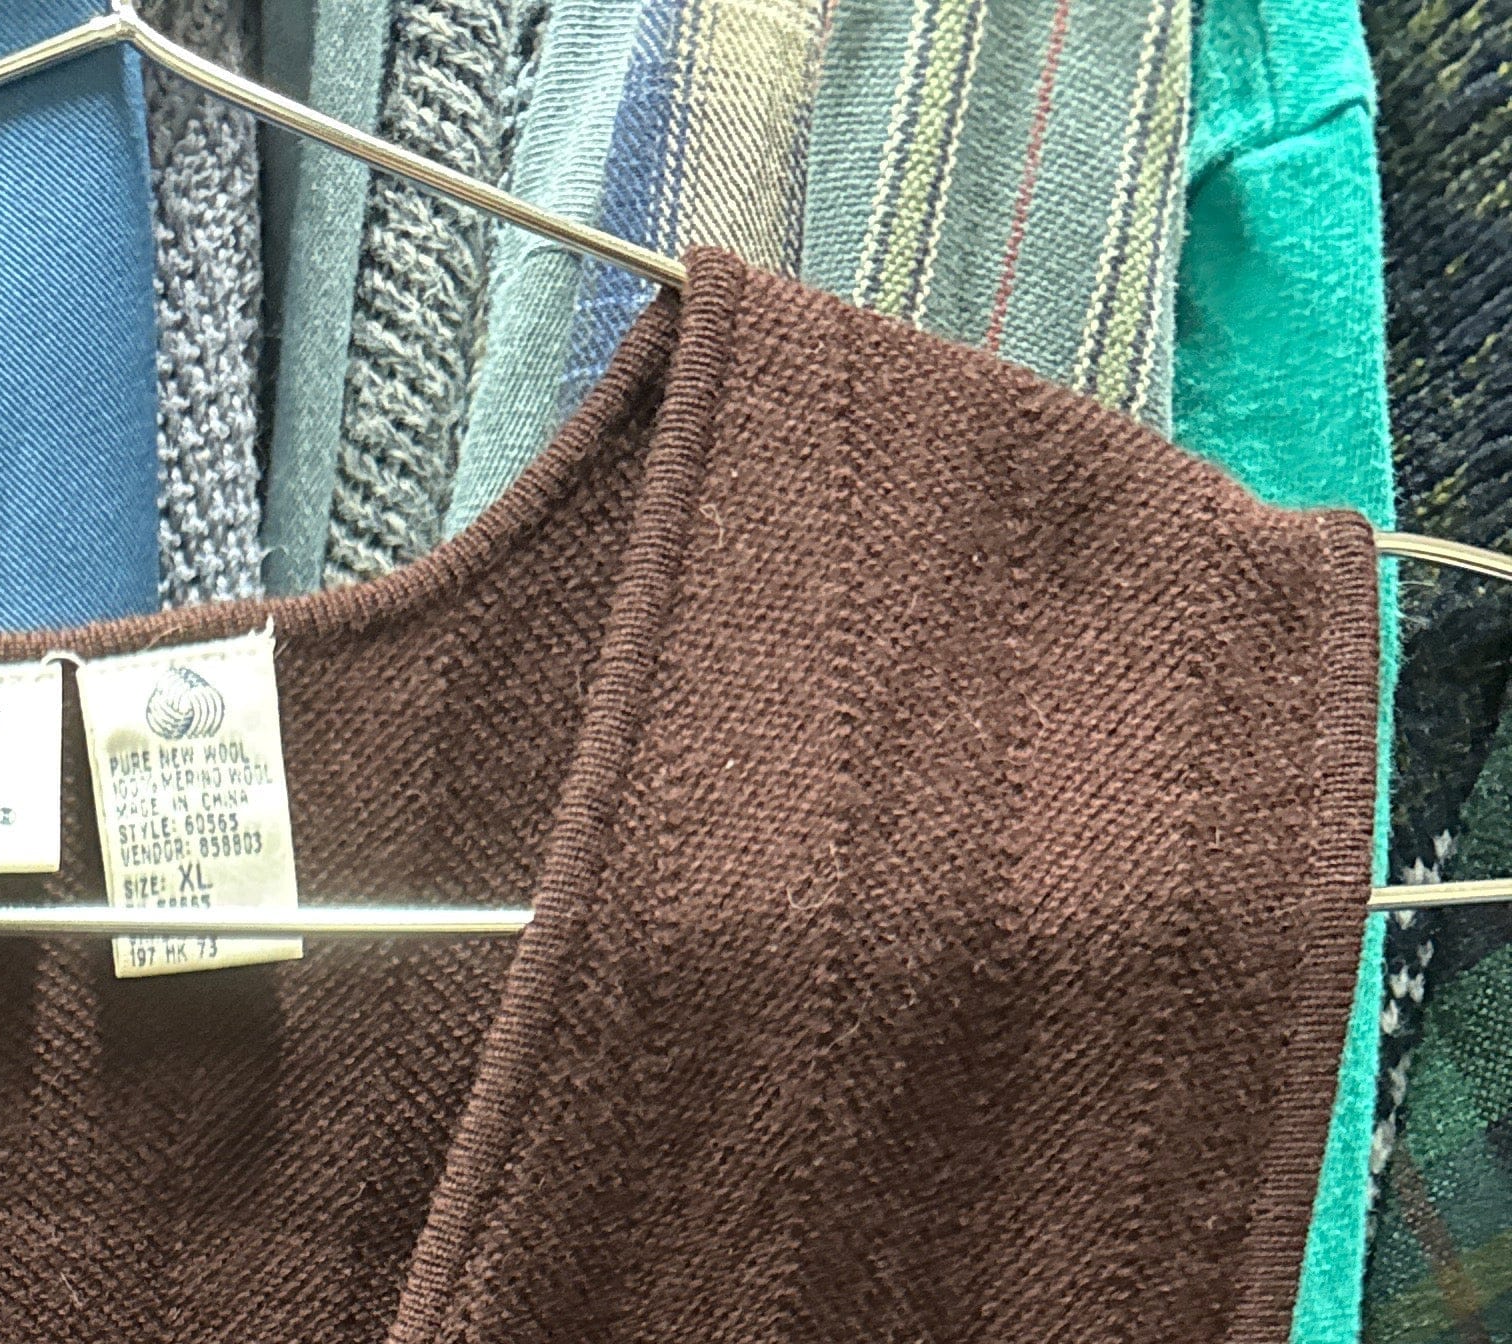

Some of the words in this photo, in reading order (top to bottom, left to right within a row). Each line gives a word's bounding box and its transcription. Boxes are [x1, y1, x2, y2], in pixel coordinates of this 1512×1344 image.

[109, 750, 152, 778] PURE
[159, 744, 194, 769] NEW
[203, 739, 250, 765] WOOL
[160, 767, 222, 792] MERINO
[228, 763, 273, 786] WOOL
[116, 796, 159, 819] MADE
[173, 794, 189, 813] IN
[201, 788, 249, 812] CHINA
[118, 816, 177, 845] STYLE:
[120, 837, 192, 868] VENDOR:
[123, 875, 166, 900] SIZE:
[178, 860, 214, 892] XL
[165, 943, 188, 964] HK
[196, 938, 218, 959] 73
